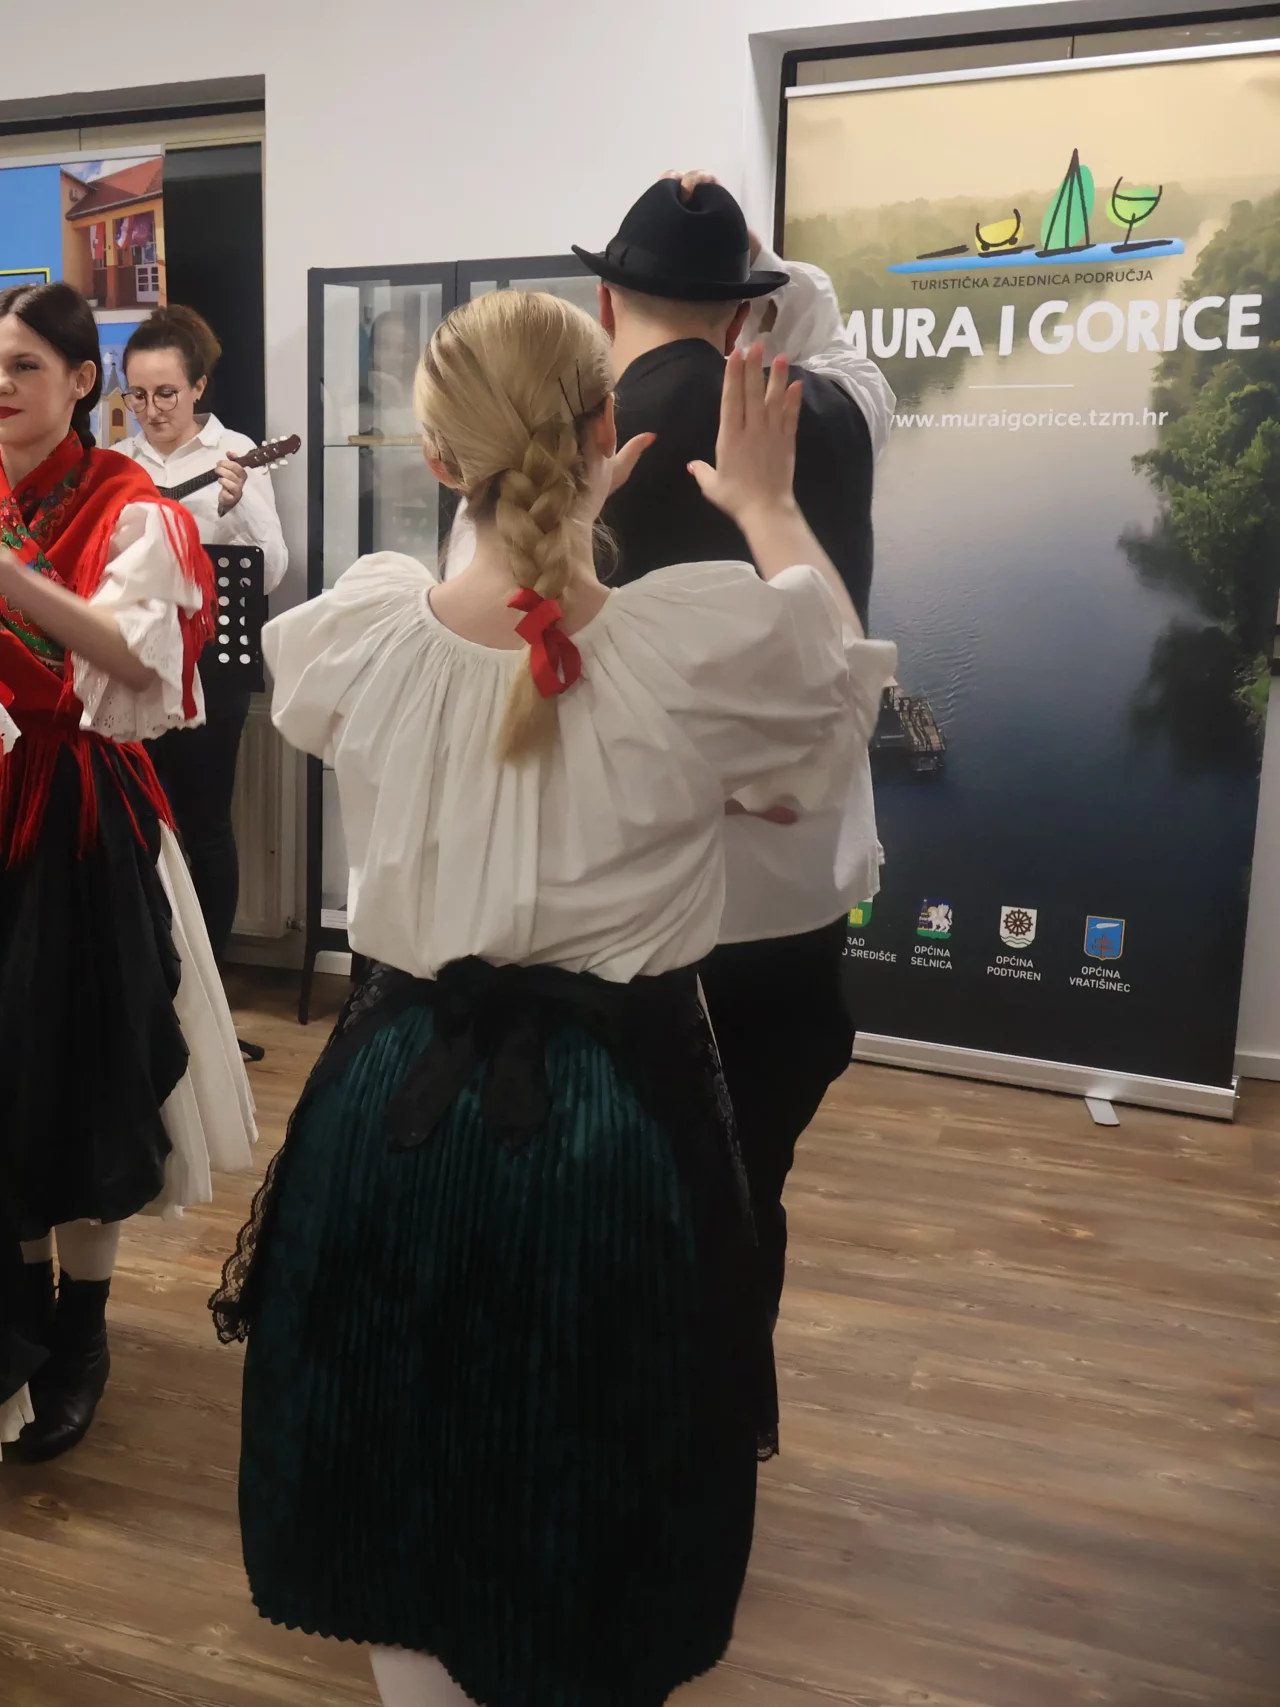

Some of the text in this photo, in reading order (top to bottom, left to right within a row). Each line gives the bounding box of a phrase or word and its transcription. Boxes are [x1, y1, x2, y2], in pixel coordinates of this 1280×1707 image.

[910, 269, 1153, 291] TURISTIČKA ZAJEDNICA PODRUČJA
[998, 305, 1015, 356] I
[1029, 294, 1263, 355] GORICE
[890, 407, 1169, 432] ww.muraigorice.tzm.hr
[847, 936, 865, 947] RAD
[850, 949, 897, 963] SREDIŠĆE
[914, 945, 951, 958] OPĆINA
[911, 956, 953, 970] SELNICA
[996, 955, 1034, 968] OPĆINA
[987, 966, 1041, 981] PODTUREN
[1081, 966, 1121, 979] OPĆINA
[1069, 977, 1131, 993] VRATIŠINEC
